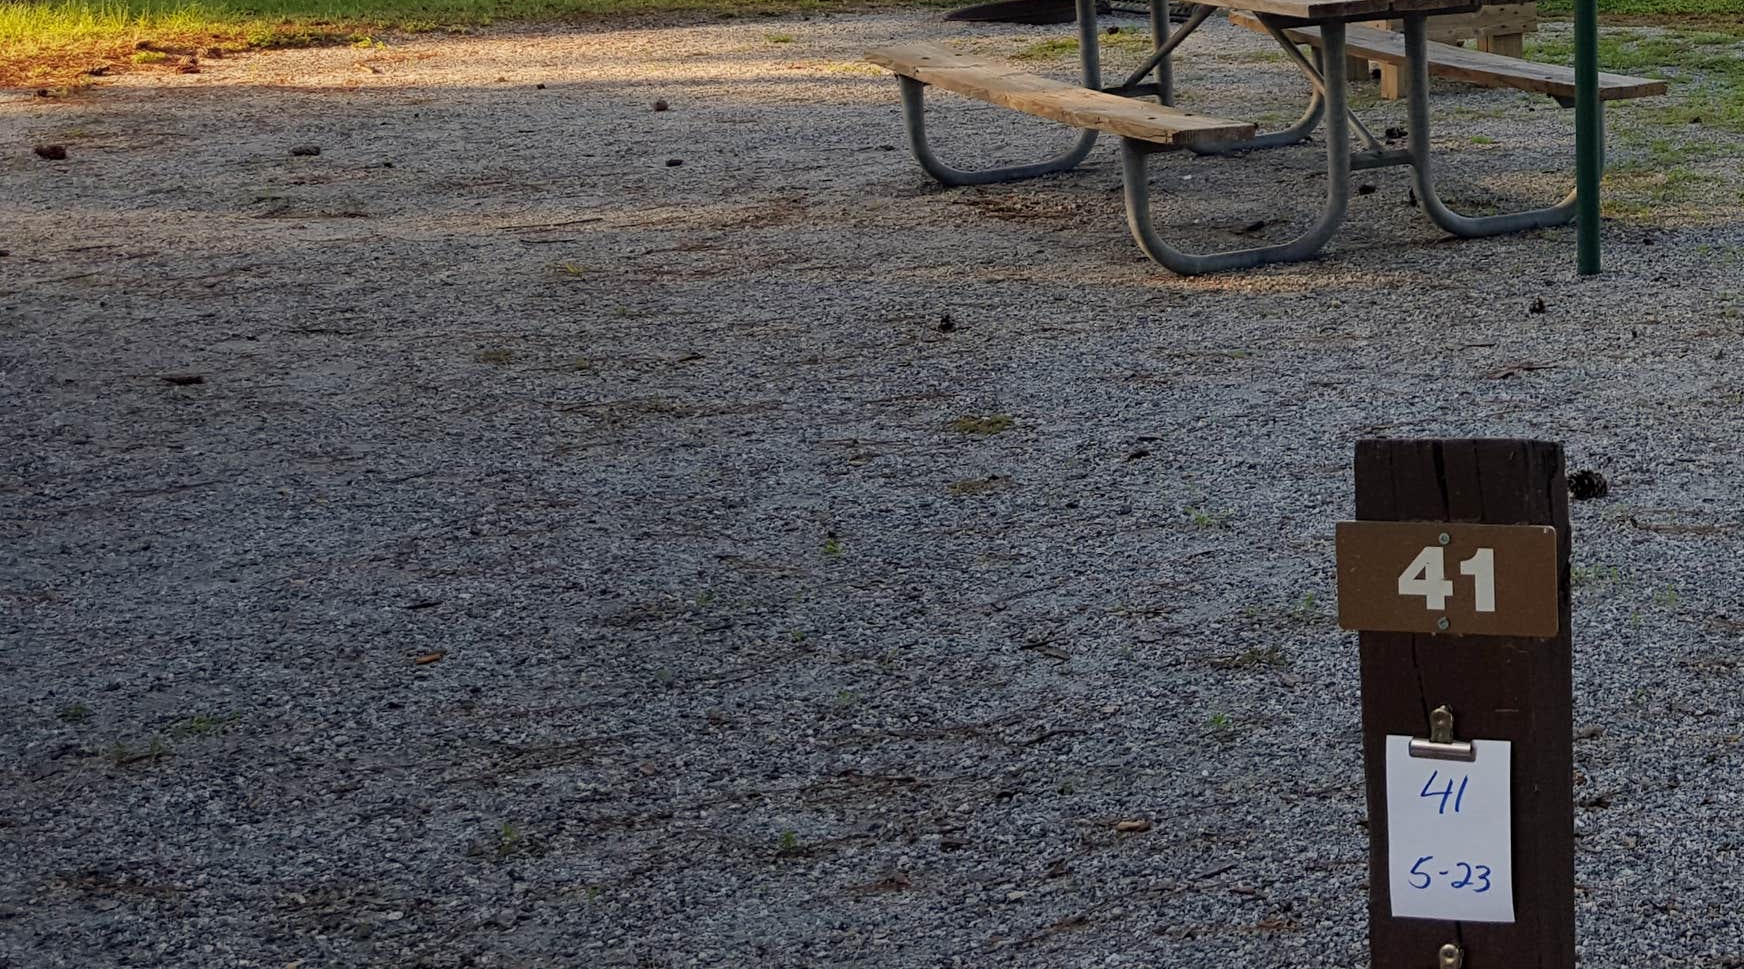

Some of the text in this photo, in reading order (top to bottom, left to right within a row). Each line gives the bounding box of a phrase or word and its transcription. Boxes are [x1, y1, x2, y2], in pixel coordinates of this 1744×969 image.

[1398, 546, 1496, 613] 41
[1420, 770, 1469, 814] 41
[1408, 855, 1493, 893] 5-23
